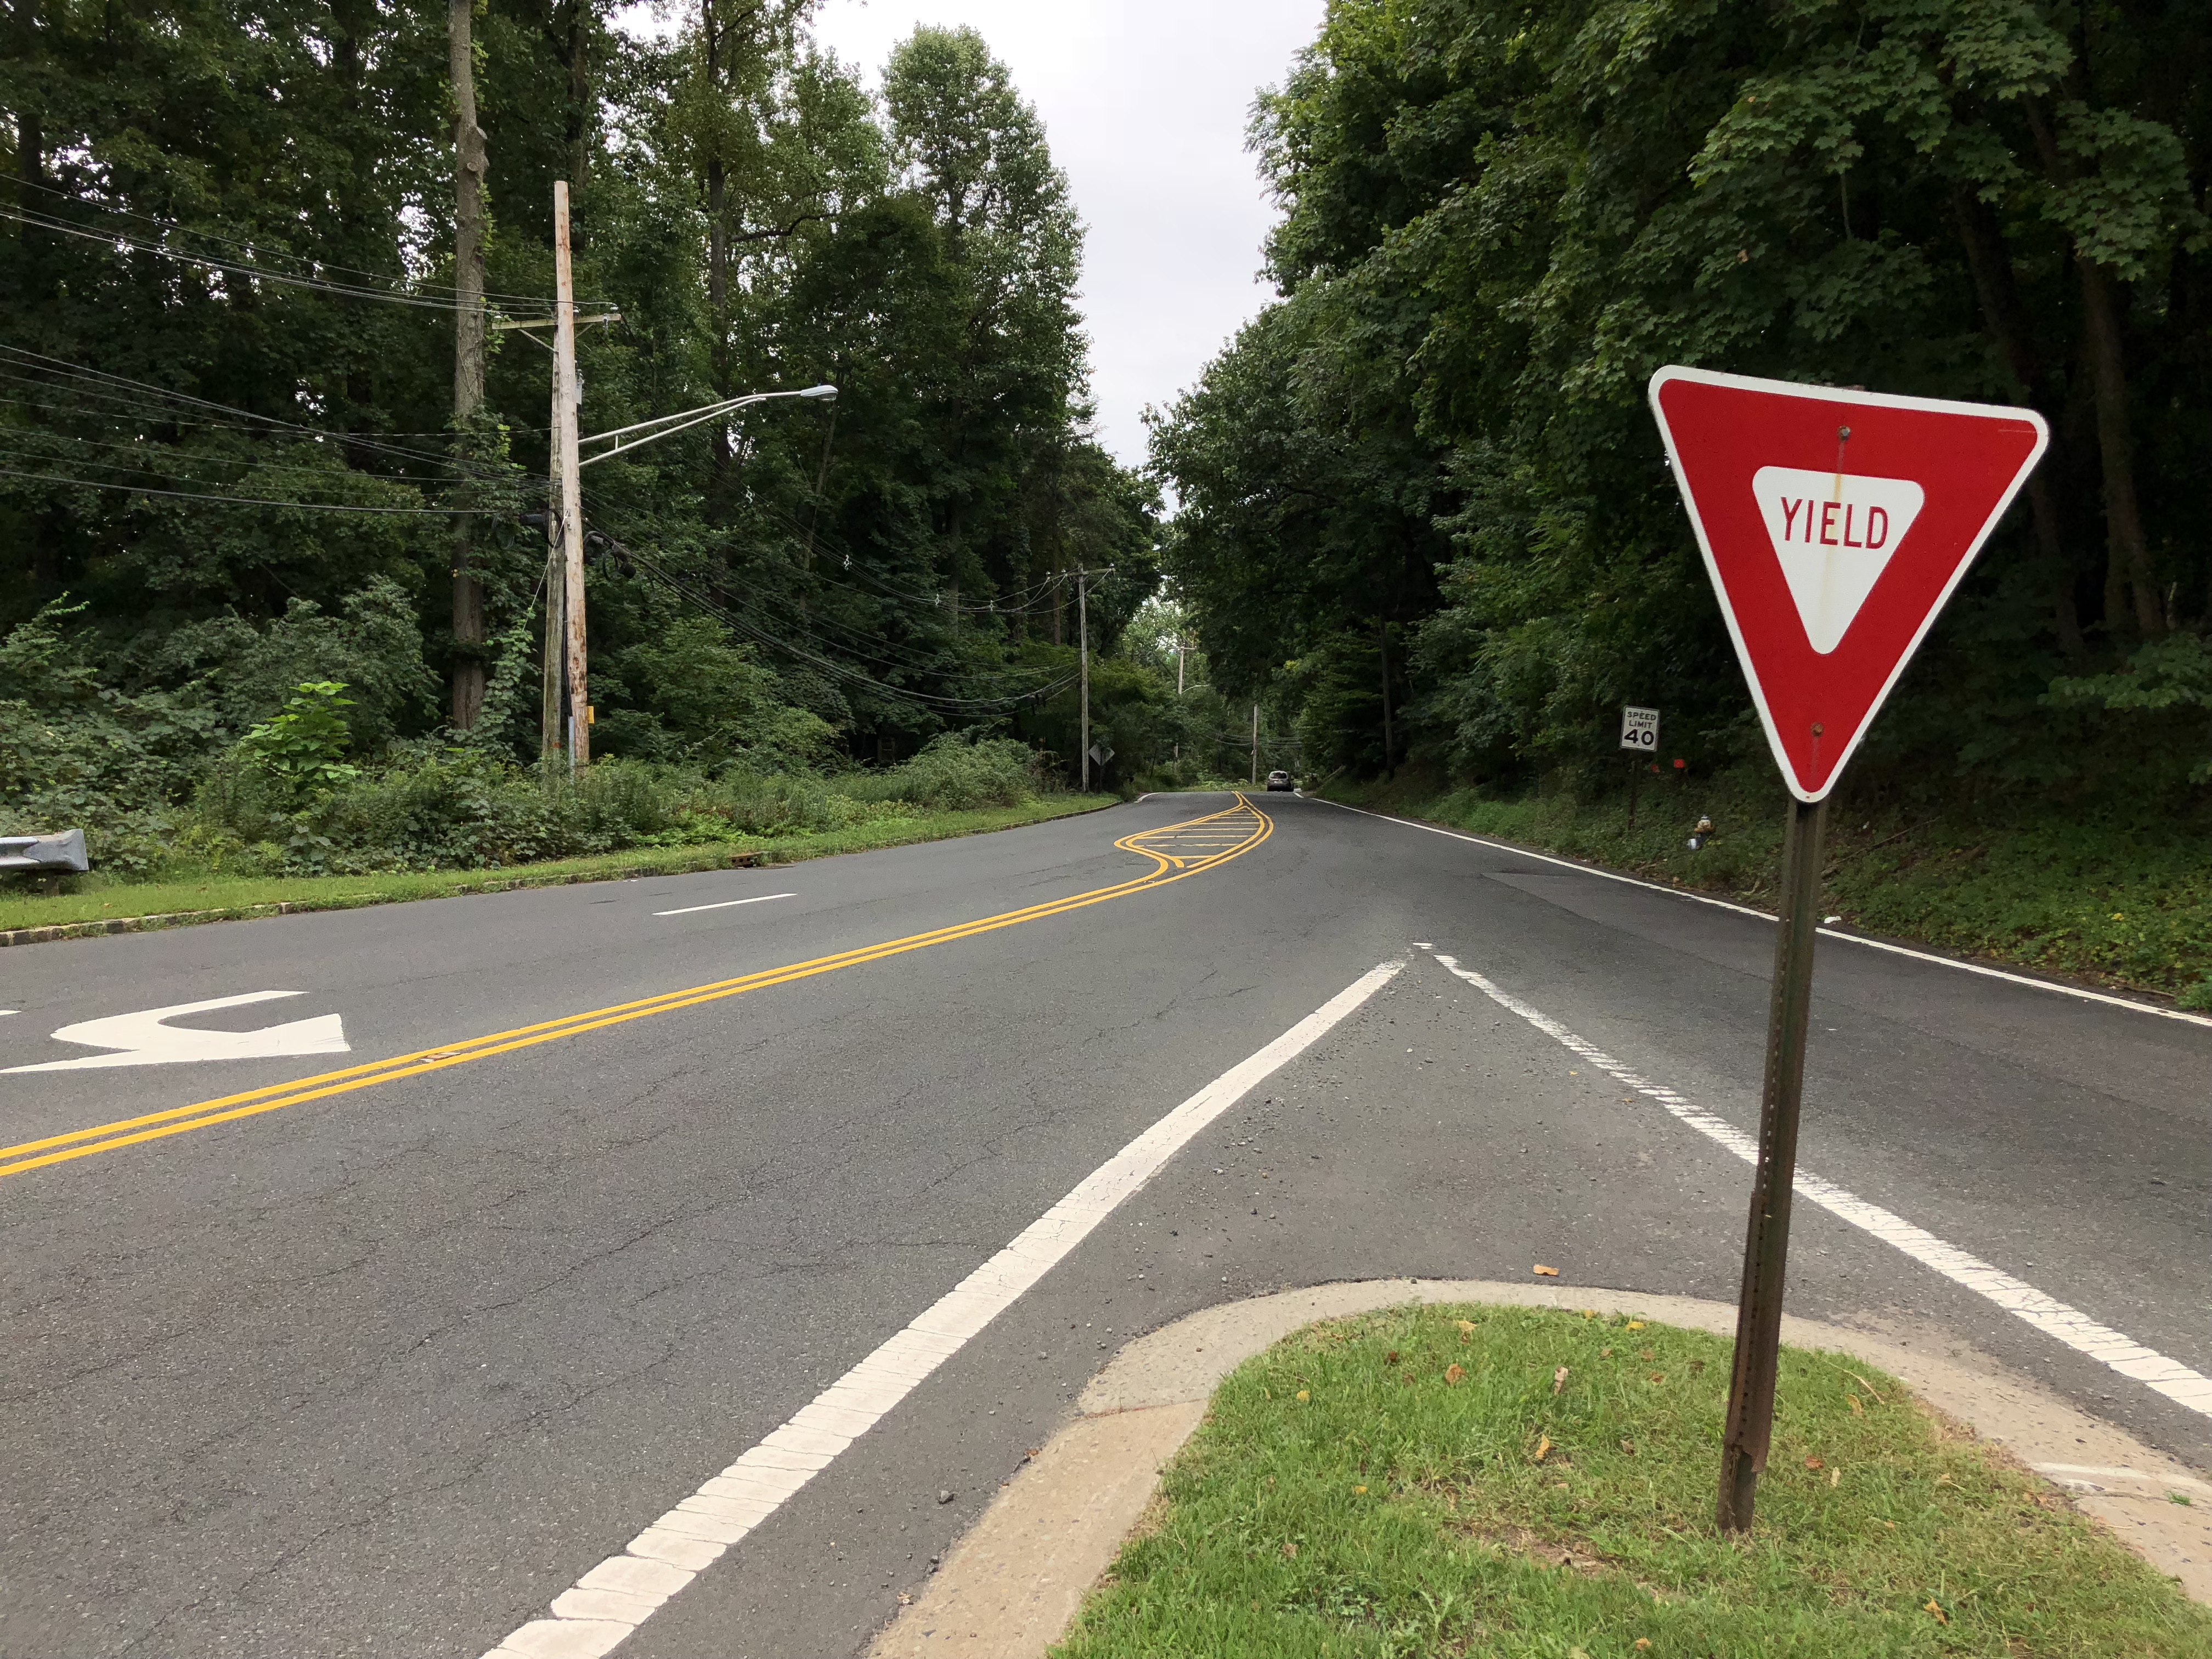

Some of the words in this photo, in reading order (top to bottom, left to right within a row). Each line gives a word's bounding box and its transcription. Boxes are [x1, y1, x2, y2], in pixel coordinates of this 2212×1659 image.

[1780, 496, 1888, 549] YIELD
[1627, 712, 1656, 720] SPEED
[1629, 720, 1652, 729] LIMIT
[1624, 729, 1654, 745] 40
